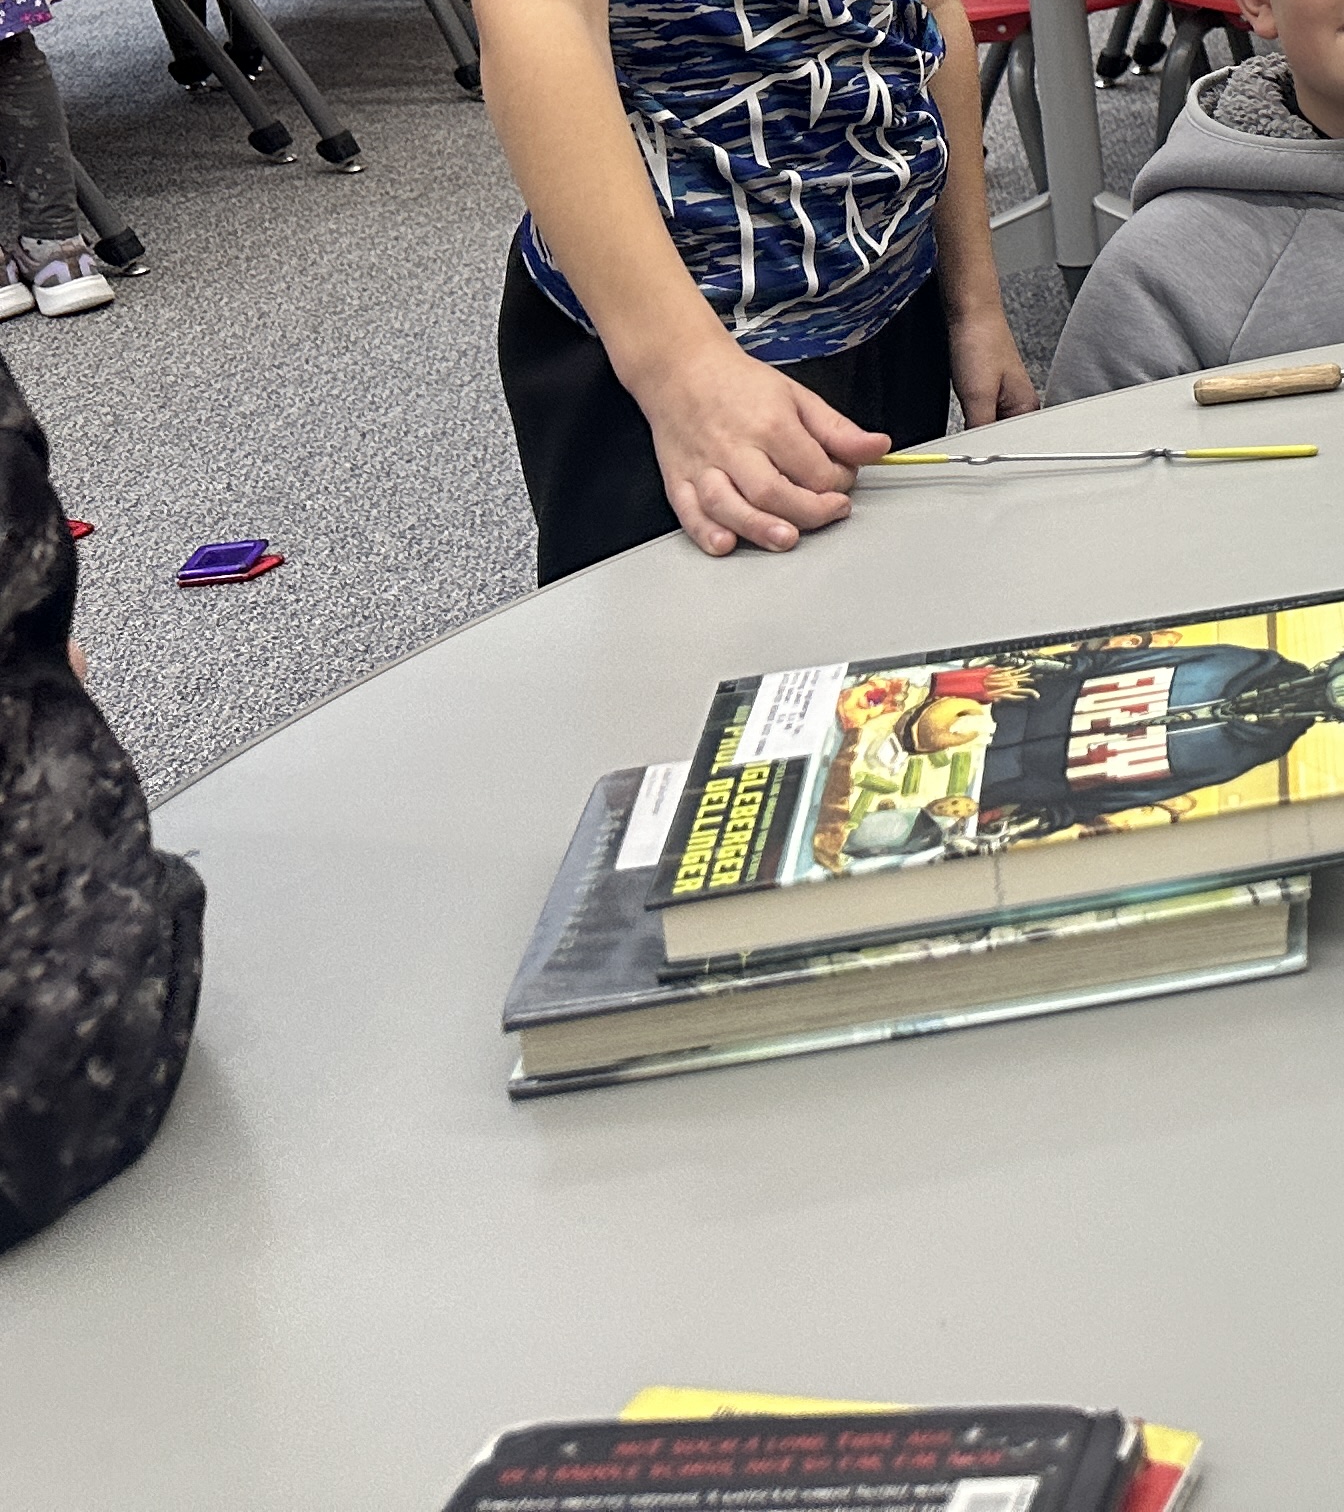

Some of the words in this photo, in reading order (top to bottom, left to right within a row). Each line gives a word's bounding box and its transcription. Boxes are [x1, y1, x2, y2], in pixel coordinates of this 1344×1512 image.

[1067, 666, 1176, 784] FUZZY
[672, 777, 735, 896] DELLINGER
[709, 759, 773, 888] GLEBERGER
